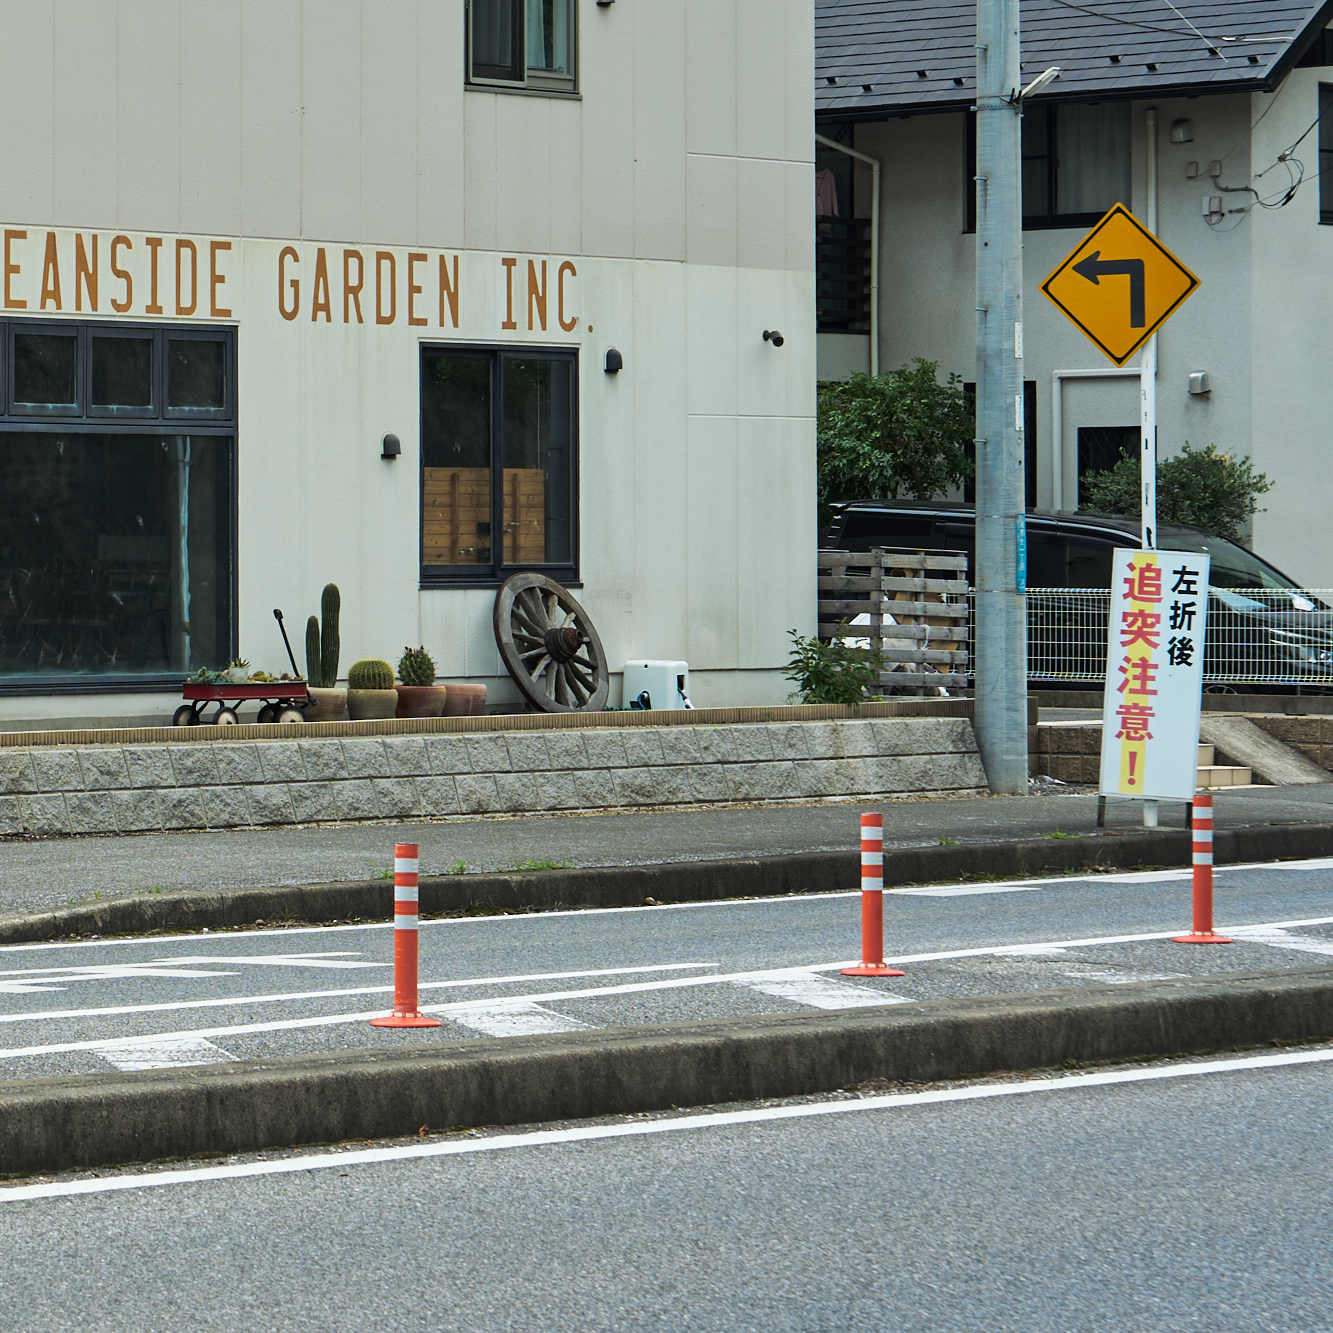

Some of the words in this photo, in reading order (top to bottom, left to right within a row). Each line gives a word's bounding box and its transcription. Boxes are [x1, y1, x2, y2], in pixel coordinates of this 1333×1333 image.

[278, 246, 460, 328] GARDEN
[501, 257, 594, 333] INC.
[1167, 565, 1199, 667] 左折後
[1115, 562, 1163, 786] 追突注意！
